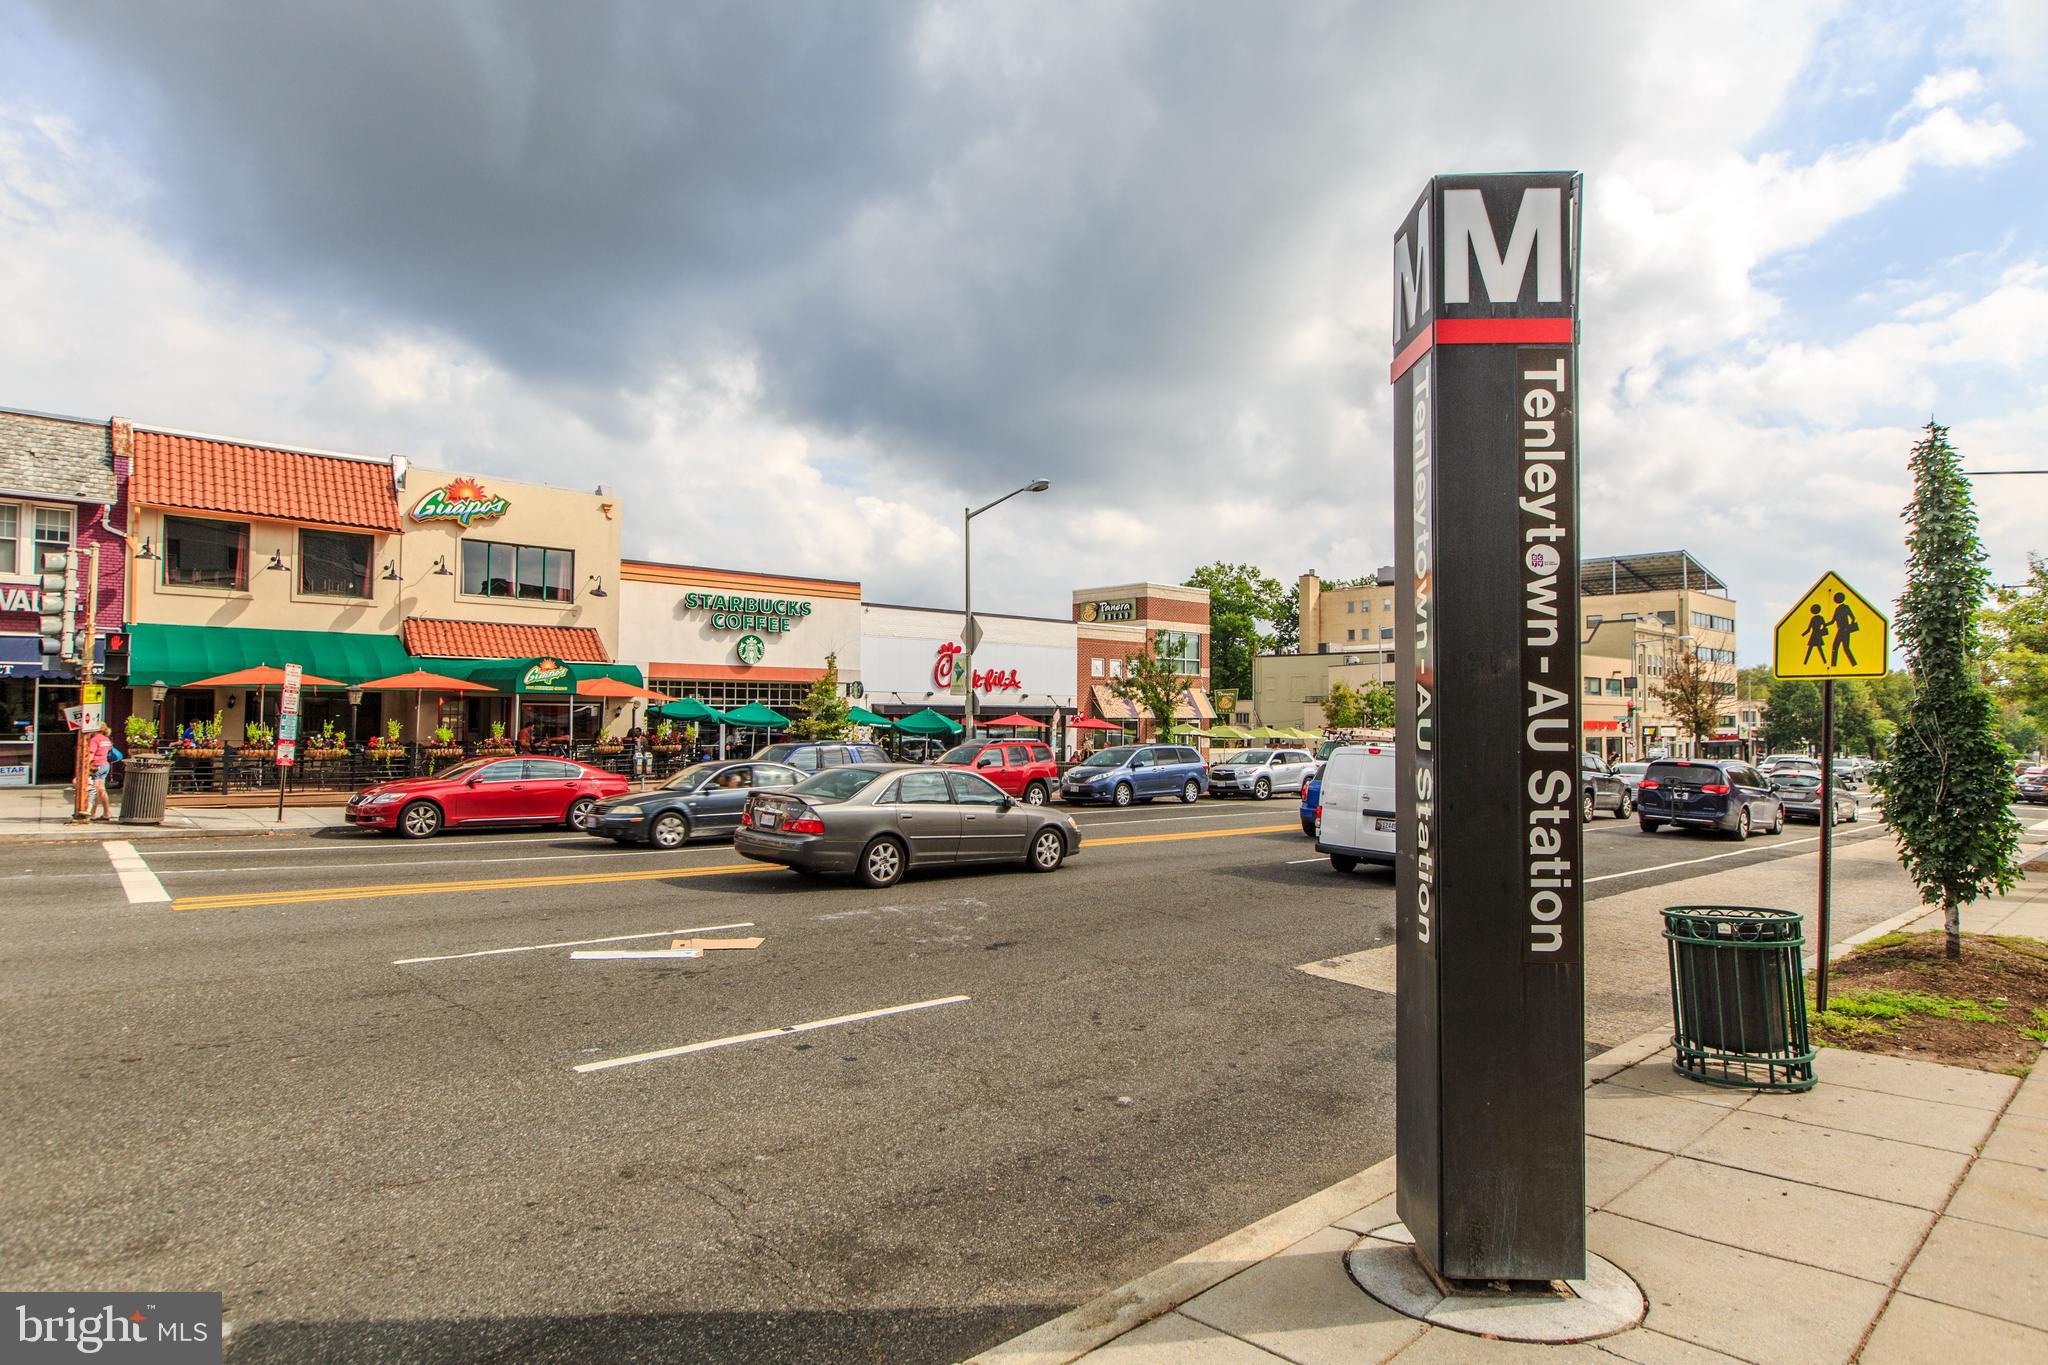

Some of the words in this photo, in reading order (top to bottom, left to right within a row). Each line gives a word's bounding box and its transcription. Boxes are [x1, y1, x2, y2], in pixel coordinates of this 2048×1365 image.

[1394, 199, 1430, 345] M
[1444, 188, 1562, 303] M
[413, 487, 506, 523] Guapo's
[1413, 365, 1431, 650] Tenleytown
[685, 592, 812, 616] STARBUCKS
[711, 613, 791, 632] COFFEE
[1100, 601, 1131, 612] Panera
[1416, 683, 1433, 751] AU
[1526, 681, 1569, 752] AU
[1416, 767, 1434, 945] Station
[1527, 770, 1572, 952] Station
